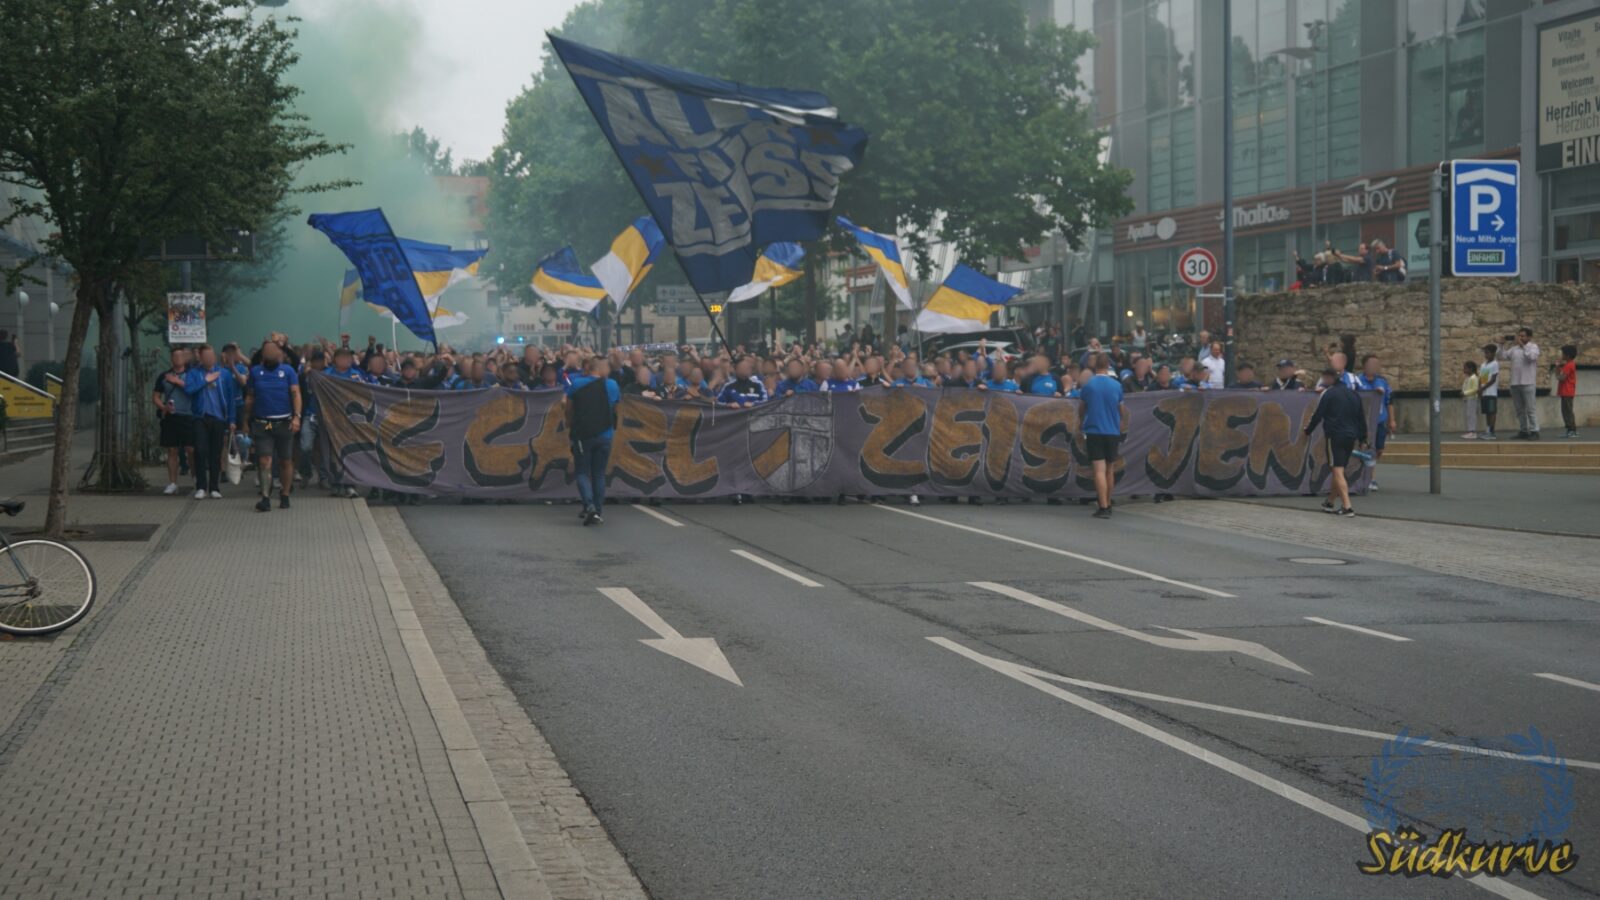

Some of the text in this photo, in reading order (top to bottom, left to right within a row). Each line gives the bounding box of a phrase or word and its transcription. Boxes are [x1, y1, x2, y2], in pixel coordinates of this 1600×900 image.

[1561, 76, 1594, 90] Welcome
[1546, 97, 1591, 122] Herzlich
[1342, 188, 1396, 216] INJOY
[1470, 185, 1501, 231] P
[1456, 235, 1516, 243] Neue Mitte Jena
[1187, 259, 1208, 276] 30
[464, 387, 718, 493] CARL
